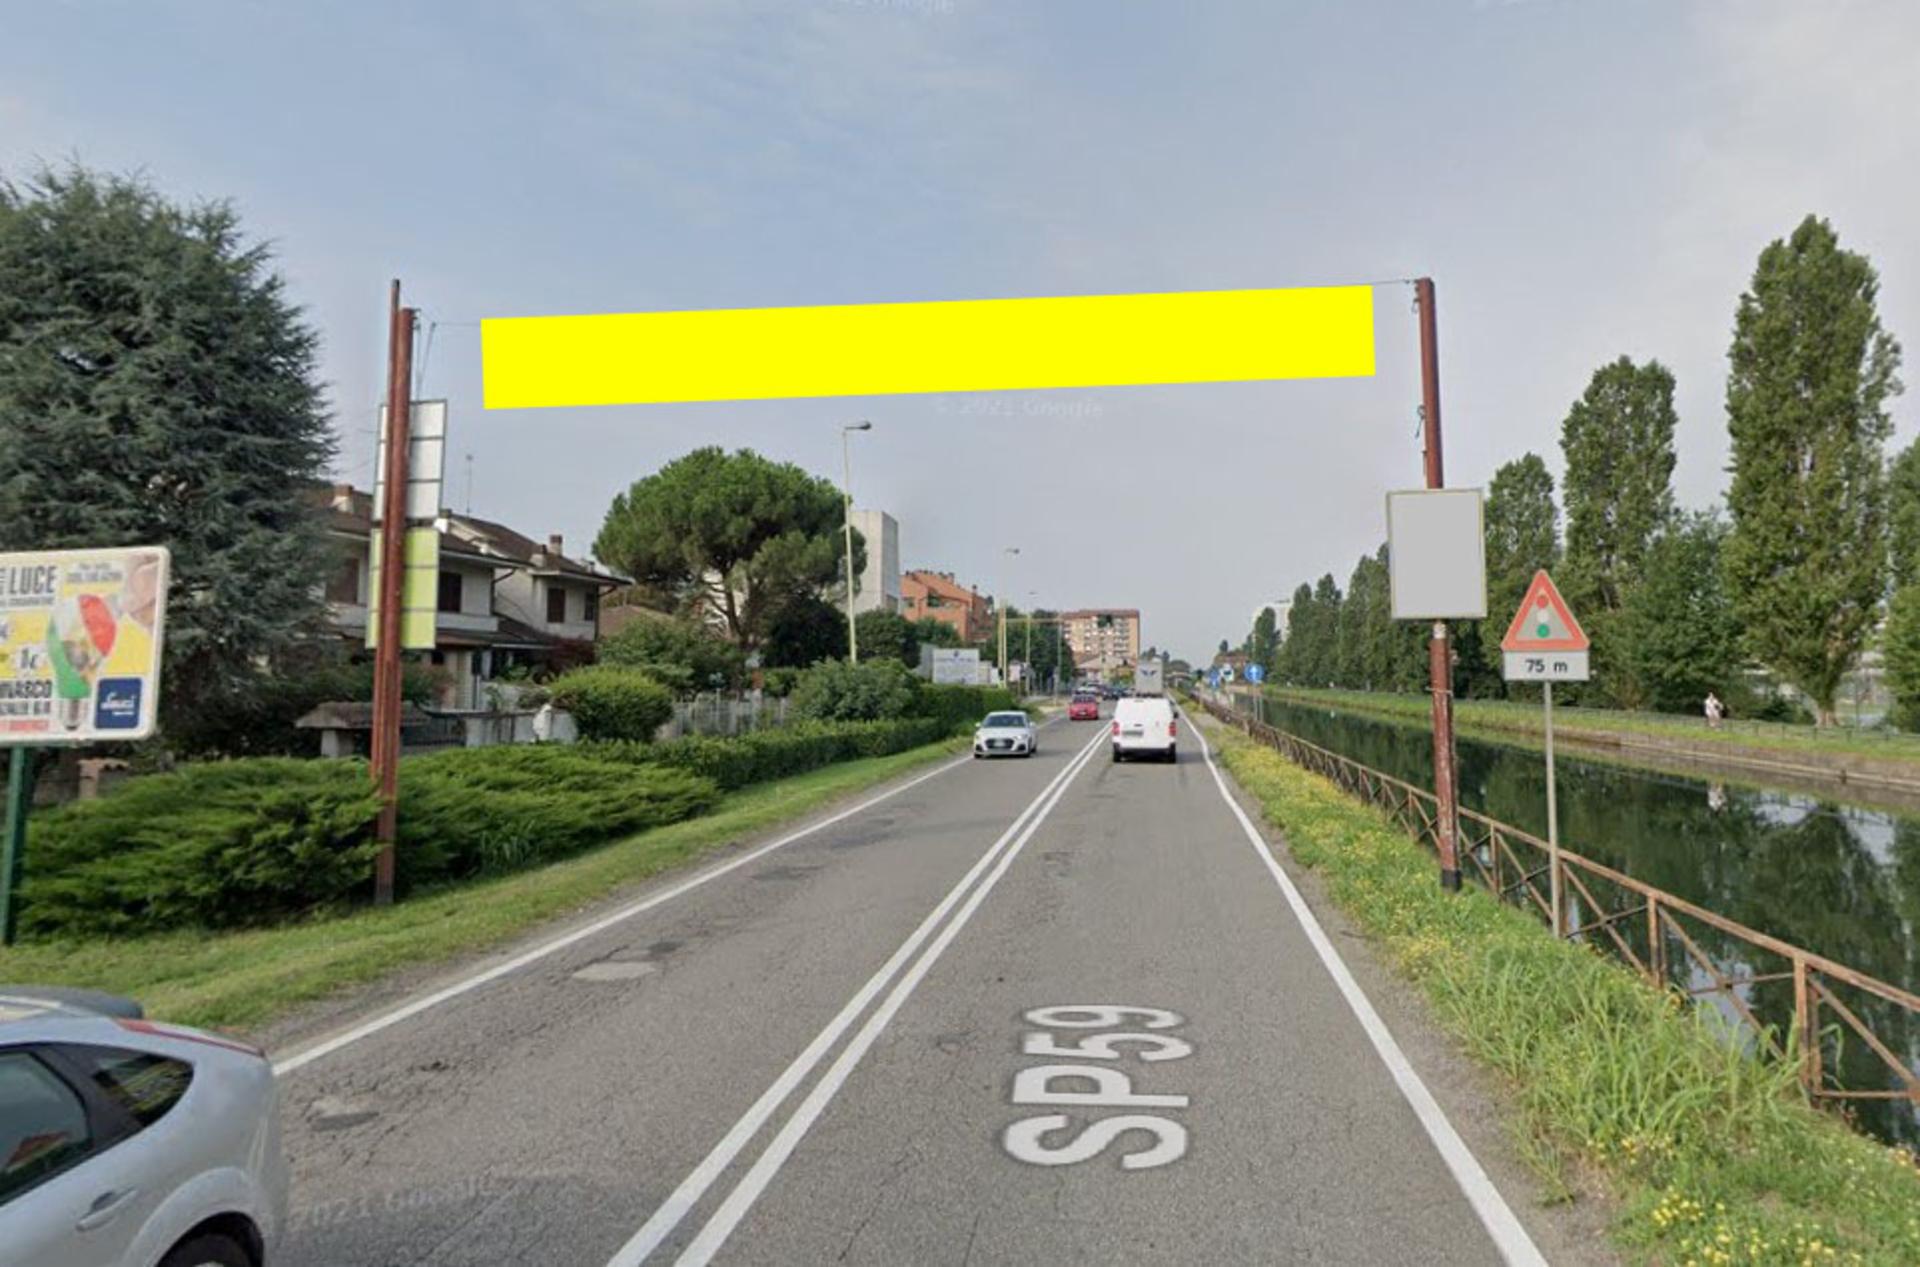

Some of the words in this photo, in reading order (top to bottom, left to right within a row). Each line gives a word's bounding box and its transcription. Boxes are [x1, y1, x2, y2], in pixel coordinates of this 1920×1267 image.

[9, 565, 57, 594] LUCE
[1525, 659, 1545, 673] 75
[1553, 661, 1568, 673] m
[1004, 1004, 1193, 1169] SP59
